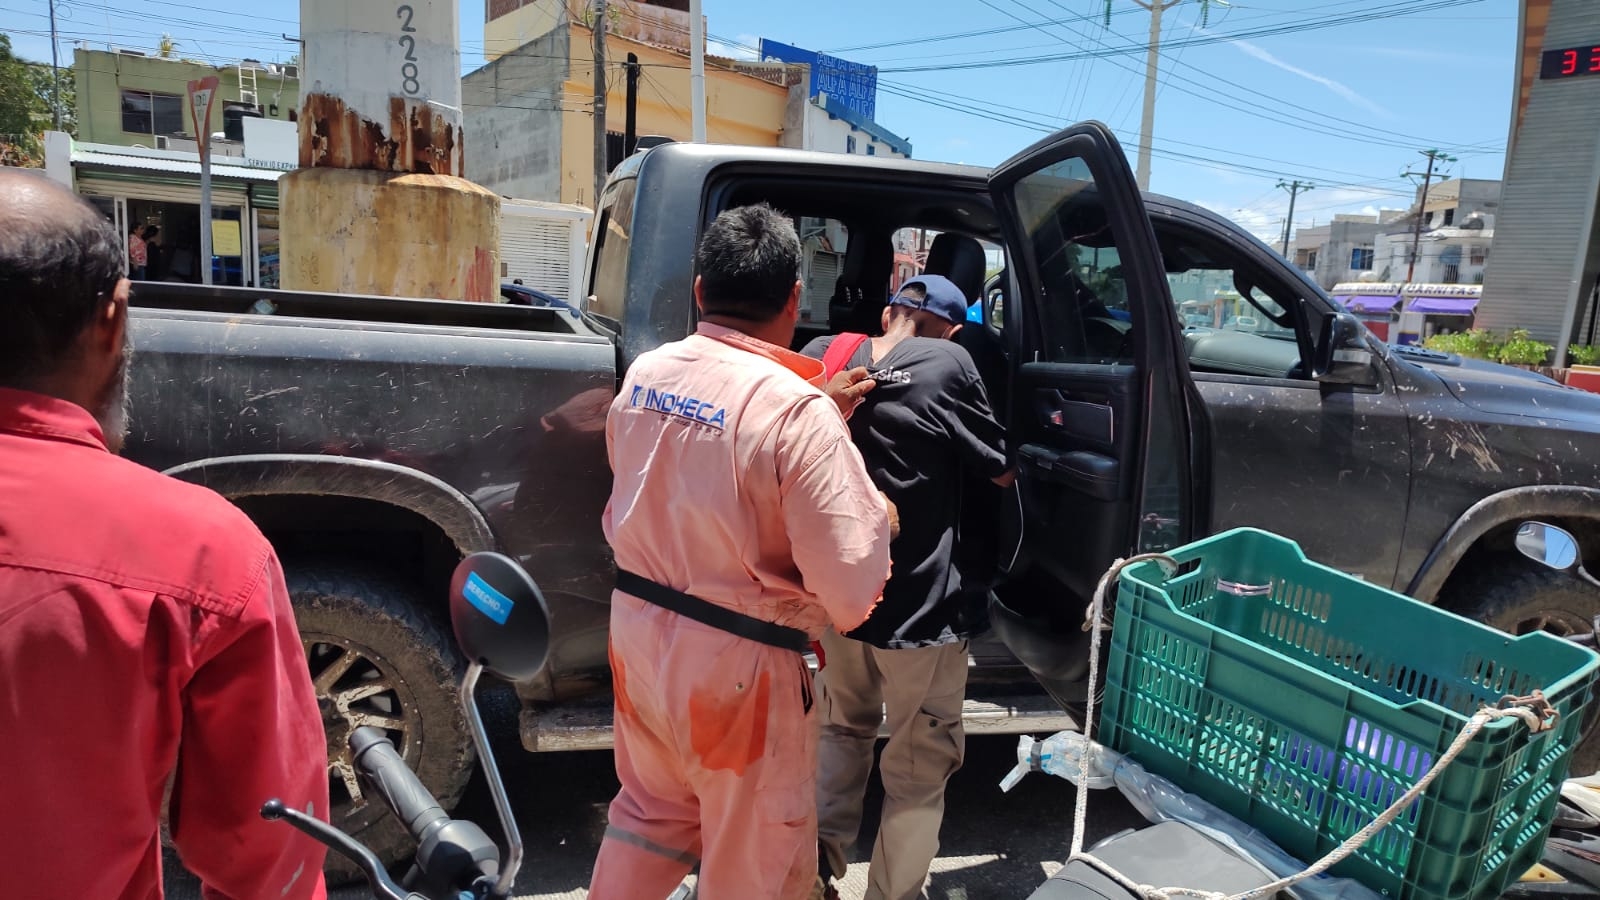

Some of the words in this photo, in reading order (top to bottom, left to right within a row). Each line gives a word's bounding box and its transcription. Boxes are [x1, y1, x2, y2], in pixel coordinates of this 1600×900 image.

[397, 5, 419, 94] 228
[817, 66, 846, 95] ALFA
[1407, 285, 1479, 295] CARNITAS
[645, 388, 725, 427] INDHECA
